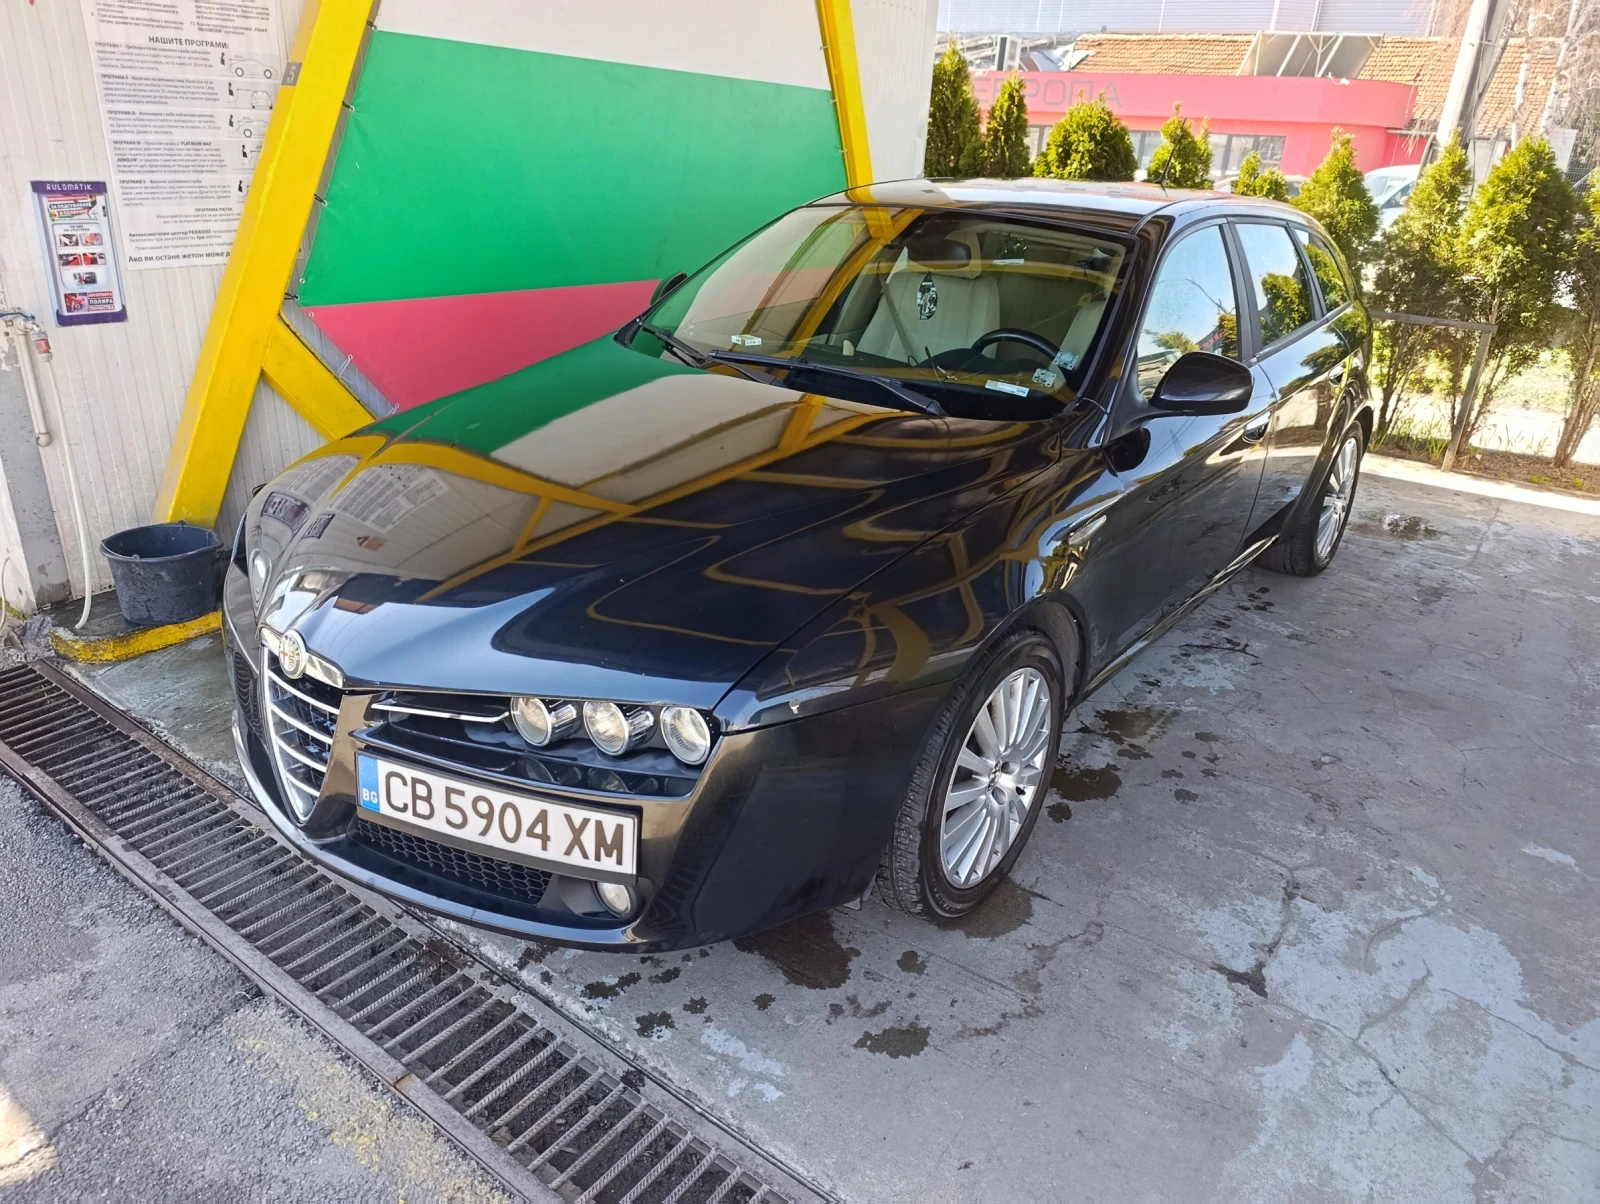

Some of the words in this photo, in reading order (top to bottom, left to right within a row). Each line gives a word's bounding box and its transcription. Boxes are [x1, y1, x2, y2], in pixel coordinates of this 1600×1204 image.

[148, 36, 183, 47] НАШИТЕ
[185, 40, 230, 50] ПРОГРАМИ:
[287, 64, 297, 84] 5
[974, 77, 1123, 109] ЕРОПА
[181, 252, 204, 260] жетон
[362, 788, 378, 804] BG
[384, 771, 435, 821] CB
[444, 785, 551, 852] 5904
[563, 813, 625, 867] XM
